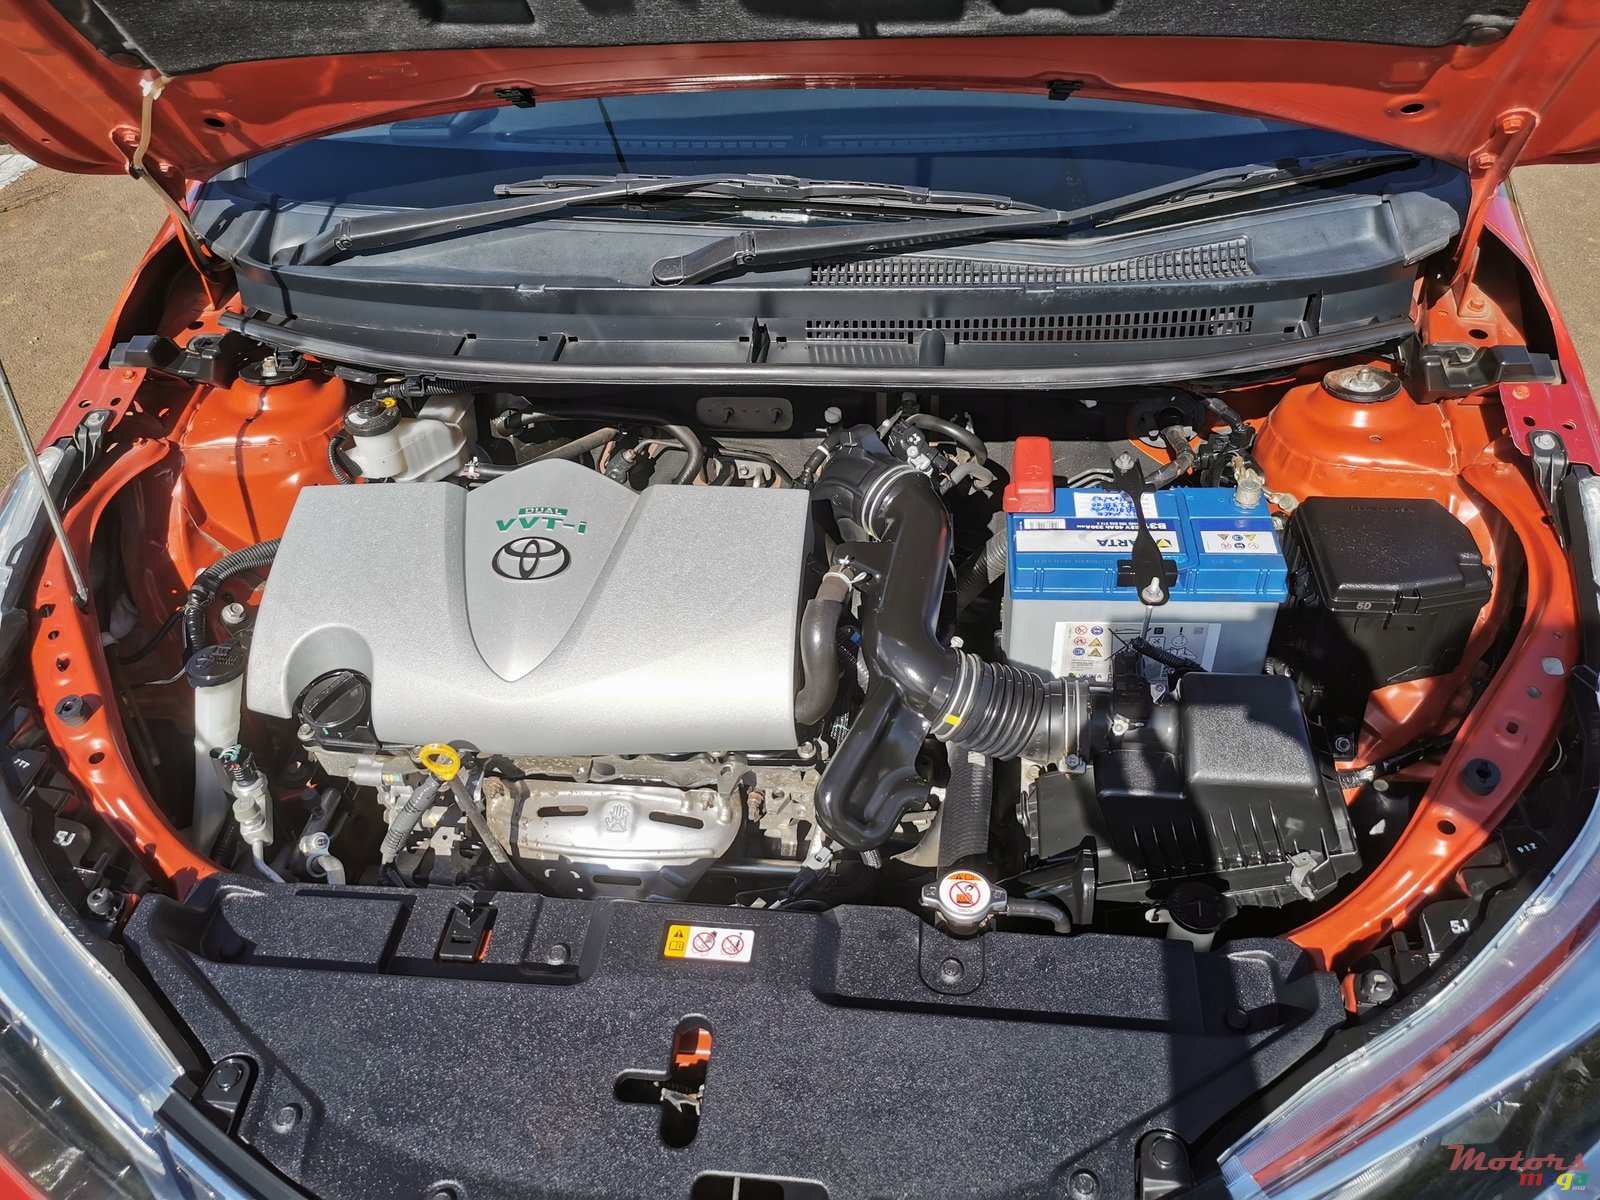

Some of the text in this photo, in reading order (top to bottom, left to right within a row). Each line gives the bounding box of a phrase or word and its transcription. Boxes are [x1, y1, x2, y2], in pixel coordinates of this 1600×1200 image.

[525, 507, 562, 515] DUAL
[496, 516, 587, 535] VVT-i
[1096, 539, 1136, 547] ARTA
